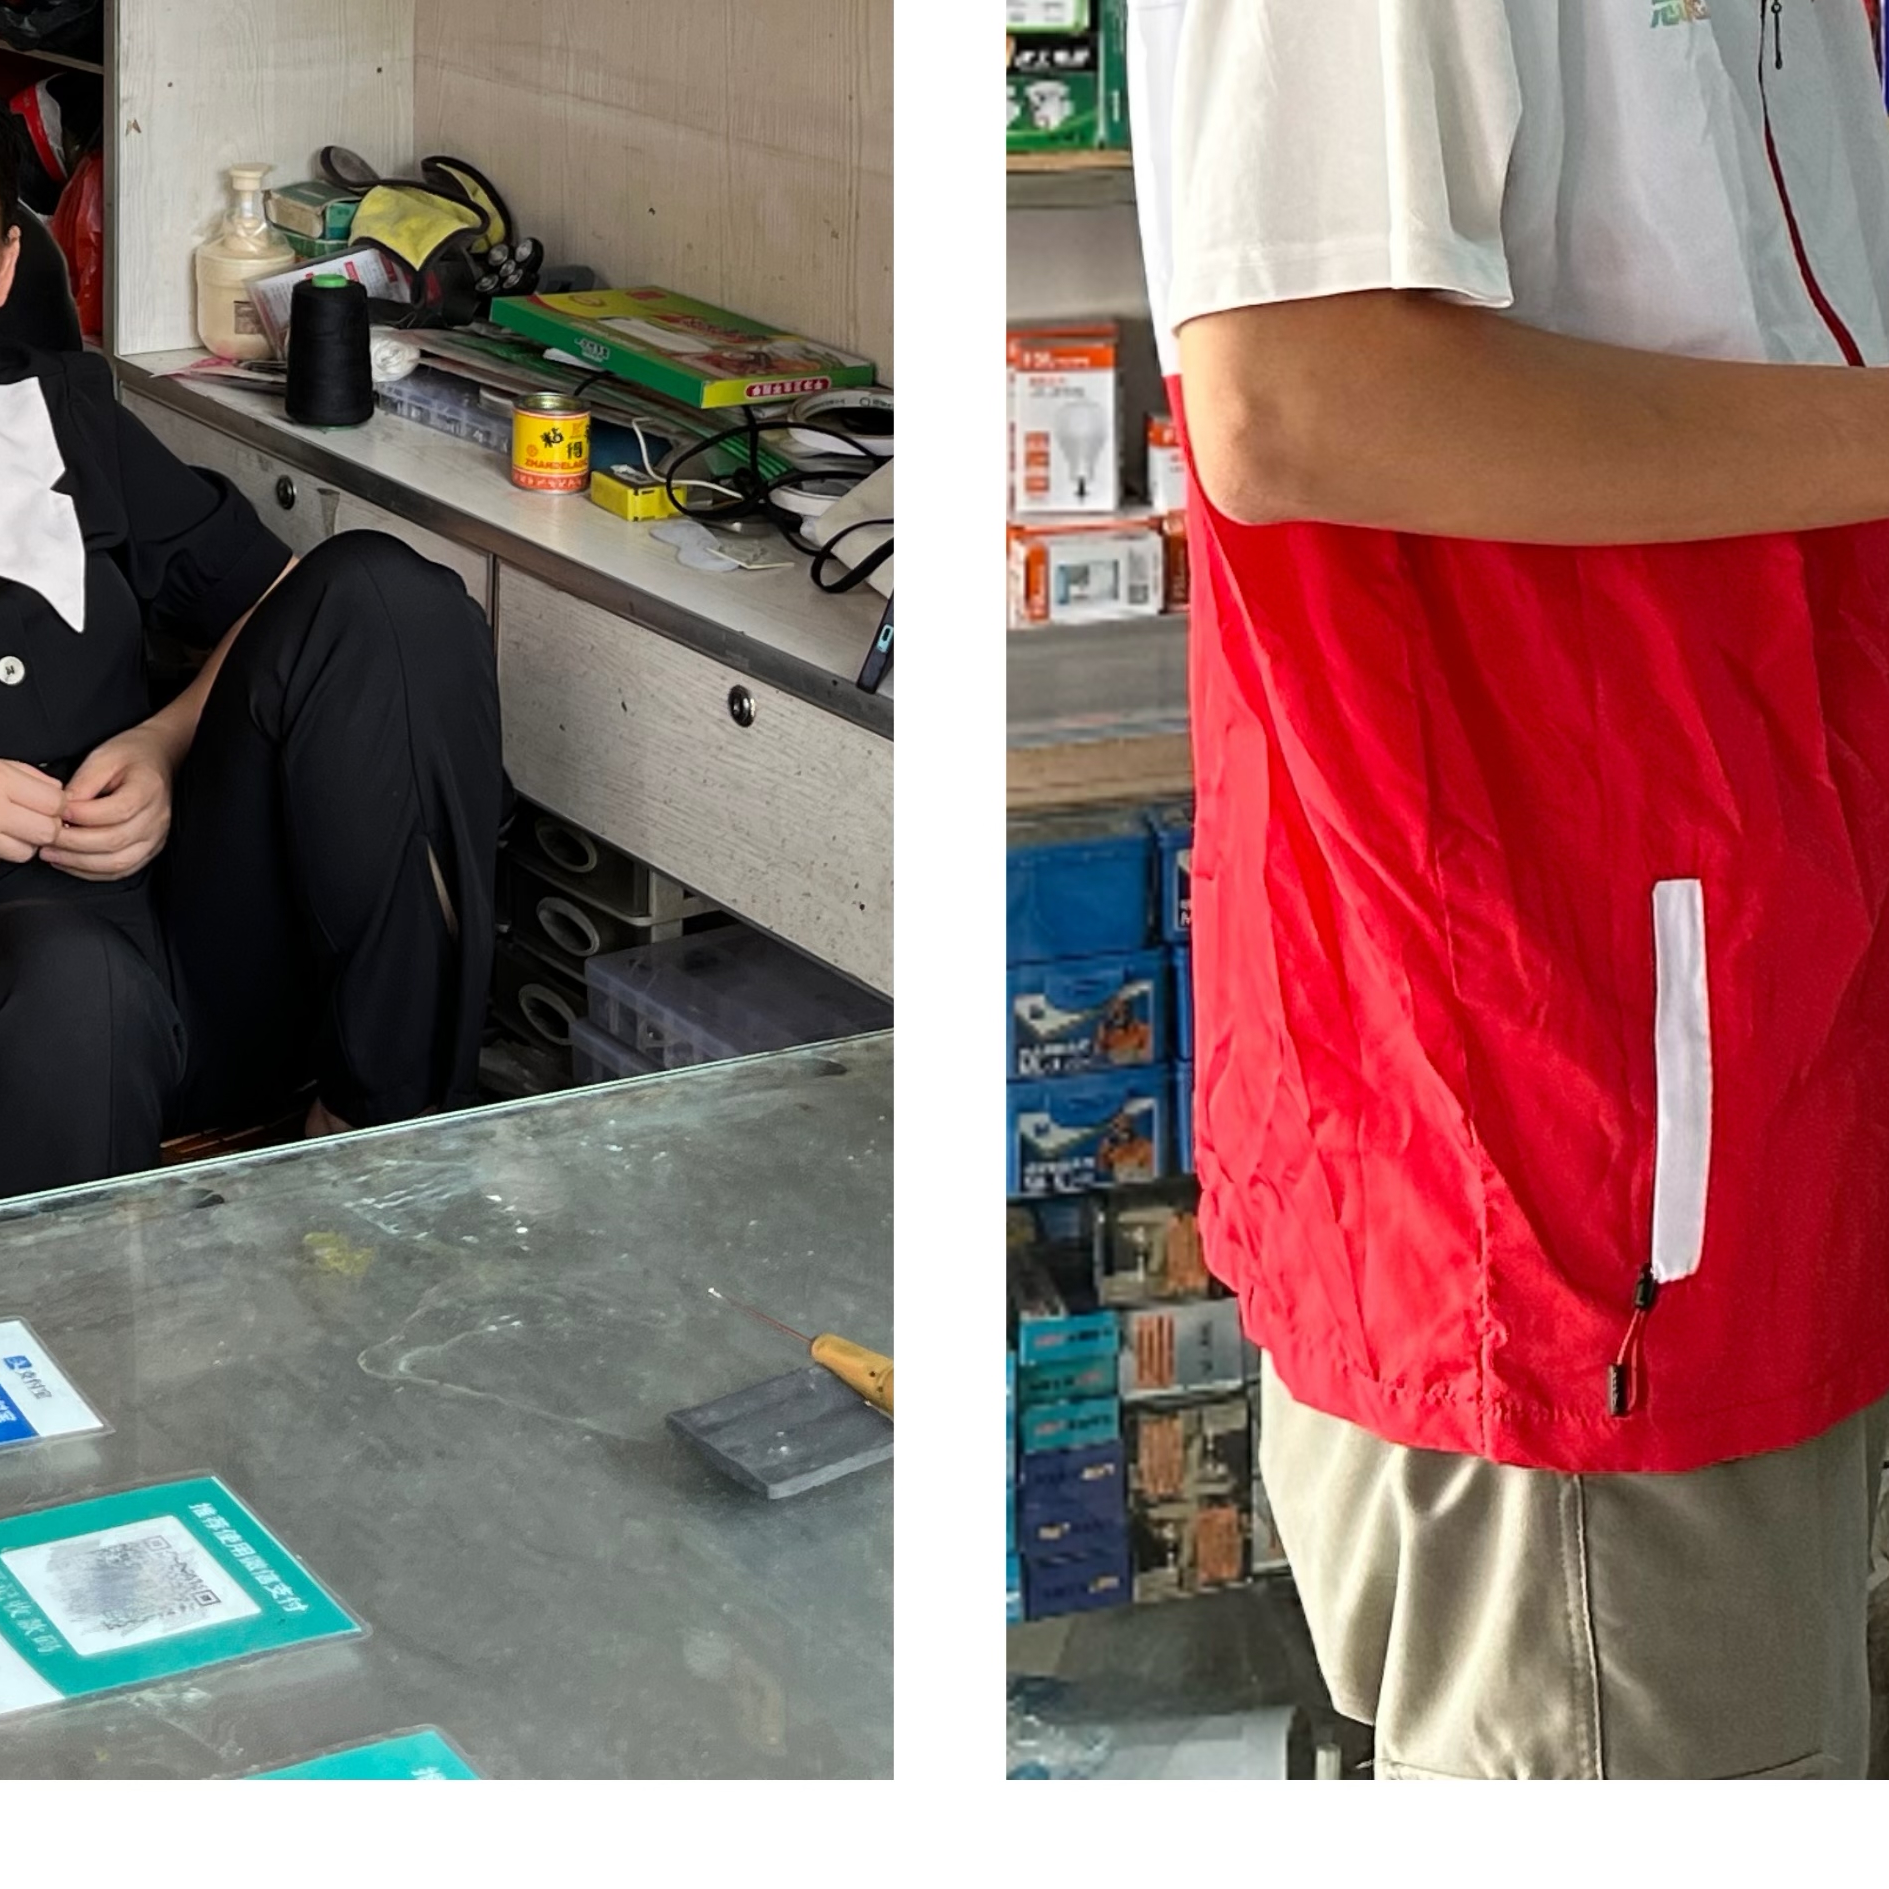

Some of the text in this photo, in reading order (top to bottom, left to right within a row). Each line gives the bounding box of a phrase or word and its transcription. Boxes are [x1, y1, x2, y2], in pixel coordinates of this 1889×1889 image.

[21, 1370, 53, 1400] 支付宝
[188, 1502, 308, 1616] 推荐使用微信支付
